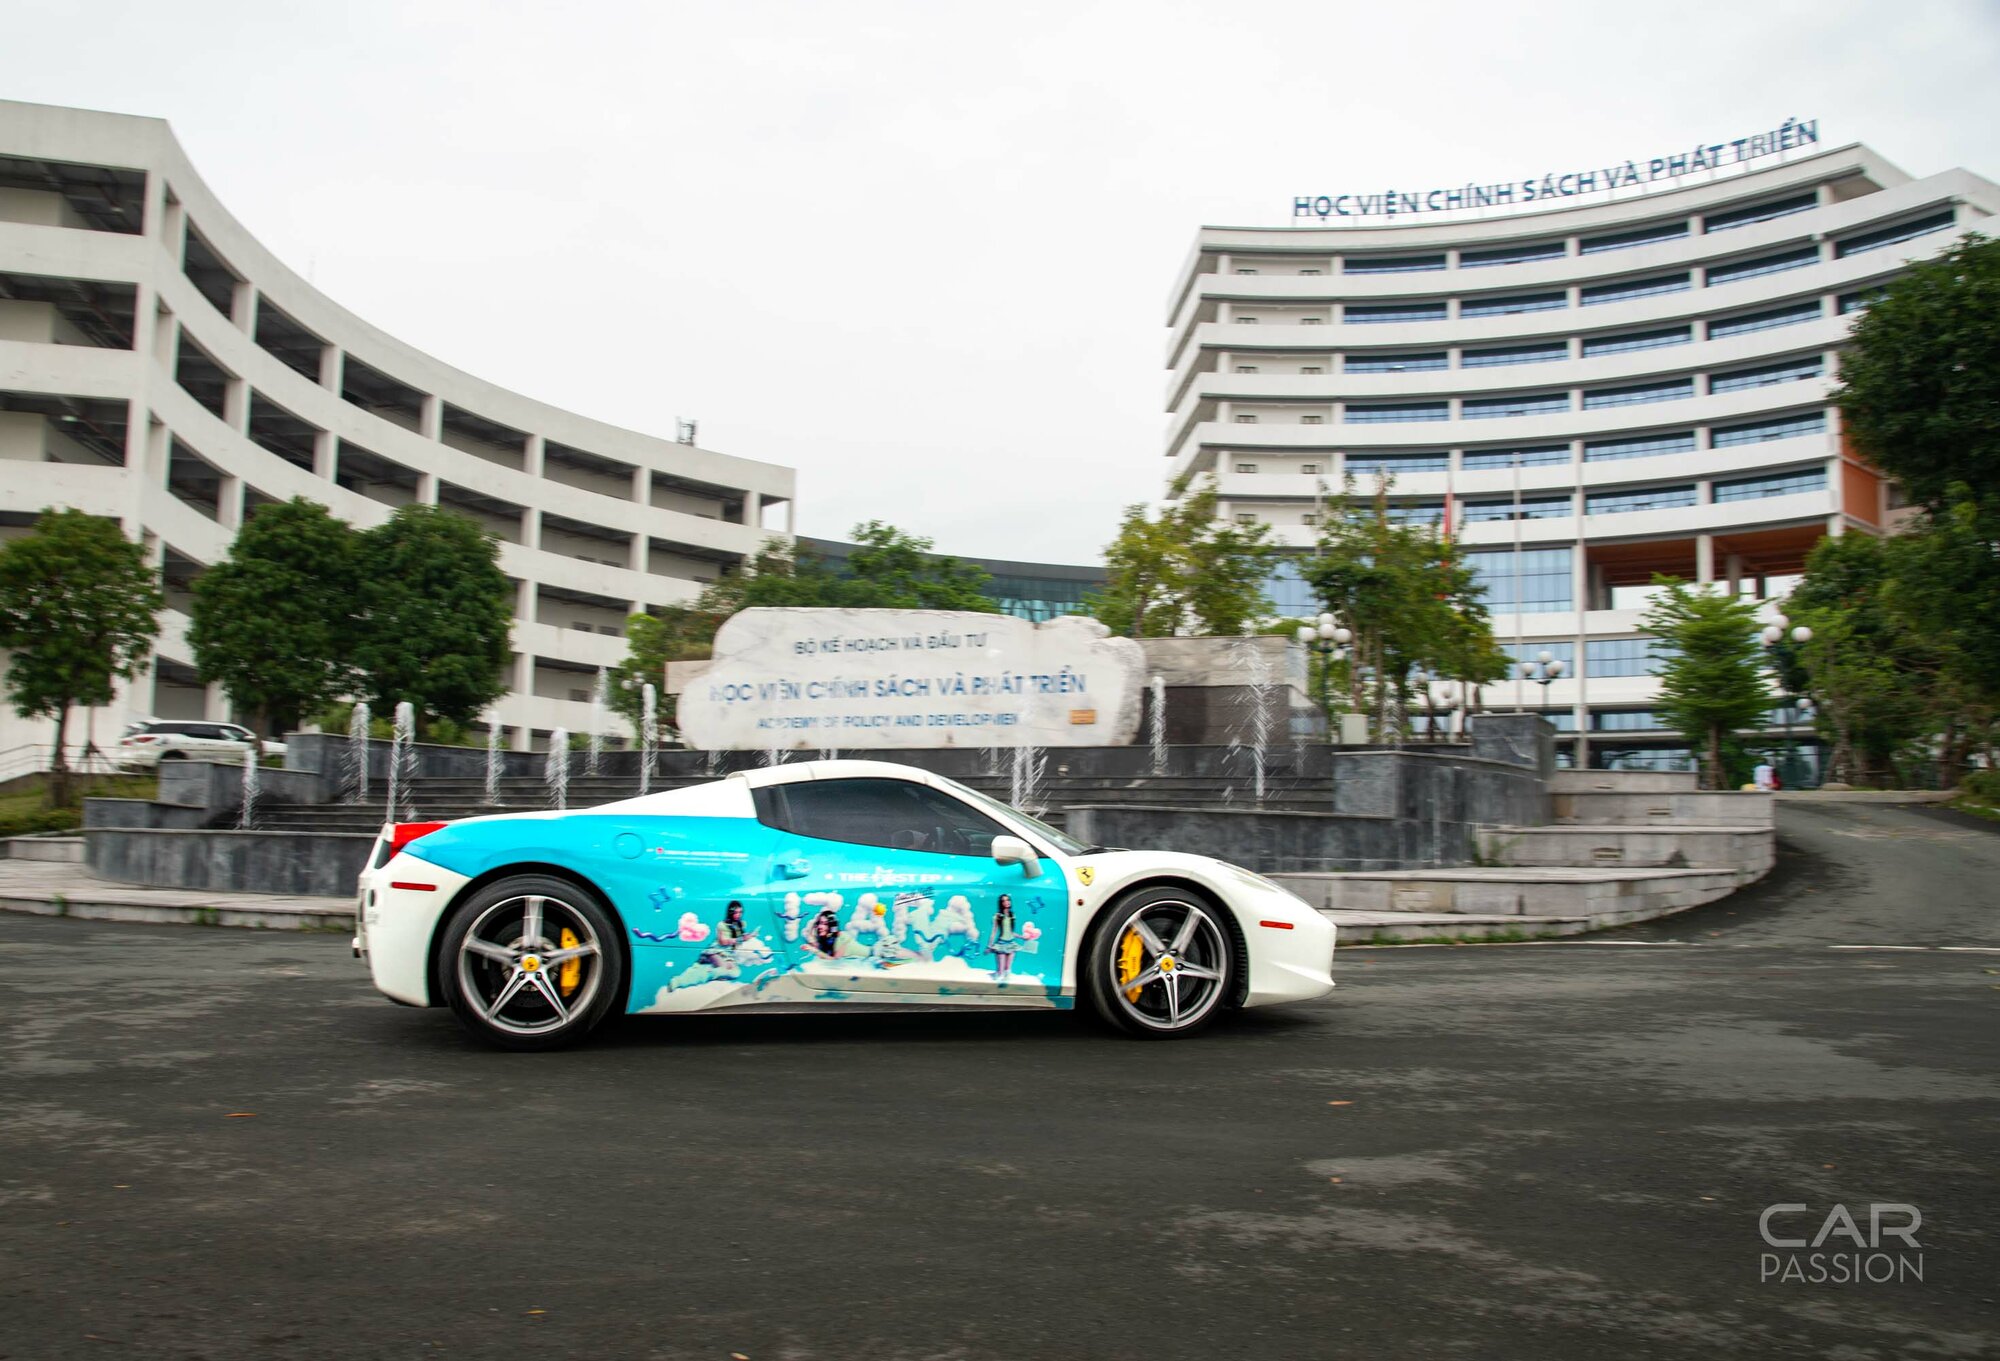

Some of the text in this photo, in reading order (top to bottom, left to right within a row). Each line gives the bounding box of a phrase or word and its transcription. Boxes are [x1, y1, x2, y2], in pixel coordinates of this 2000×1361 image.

[1293, 116, 1817, 221] HỌC VIỆN CHÍNH SÁCH VÀ PHÁT TRIỂN
[873, 673, 931, 697] SÁCH
[937, 671, 968, 695] VÀ
